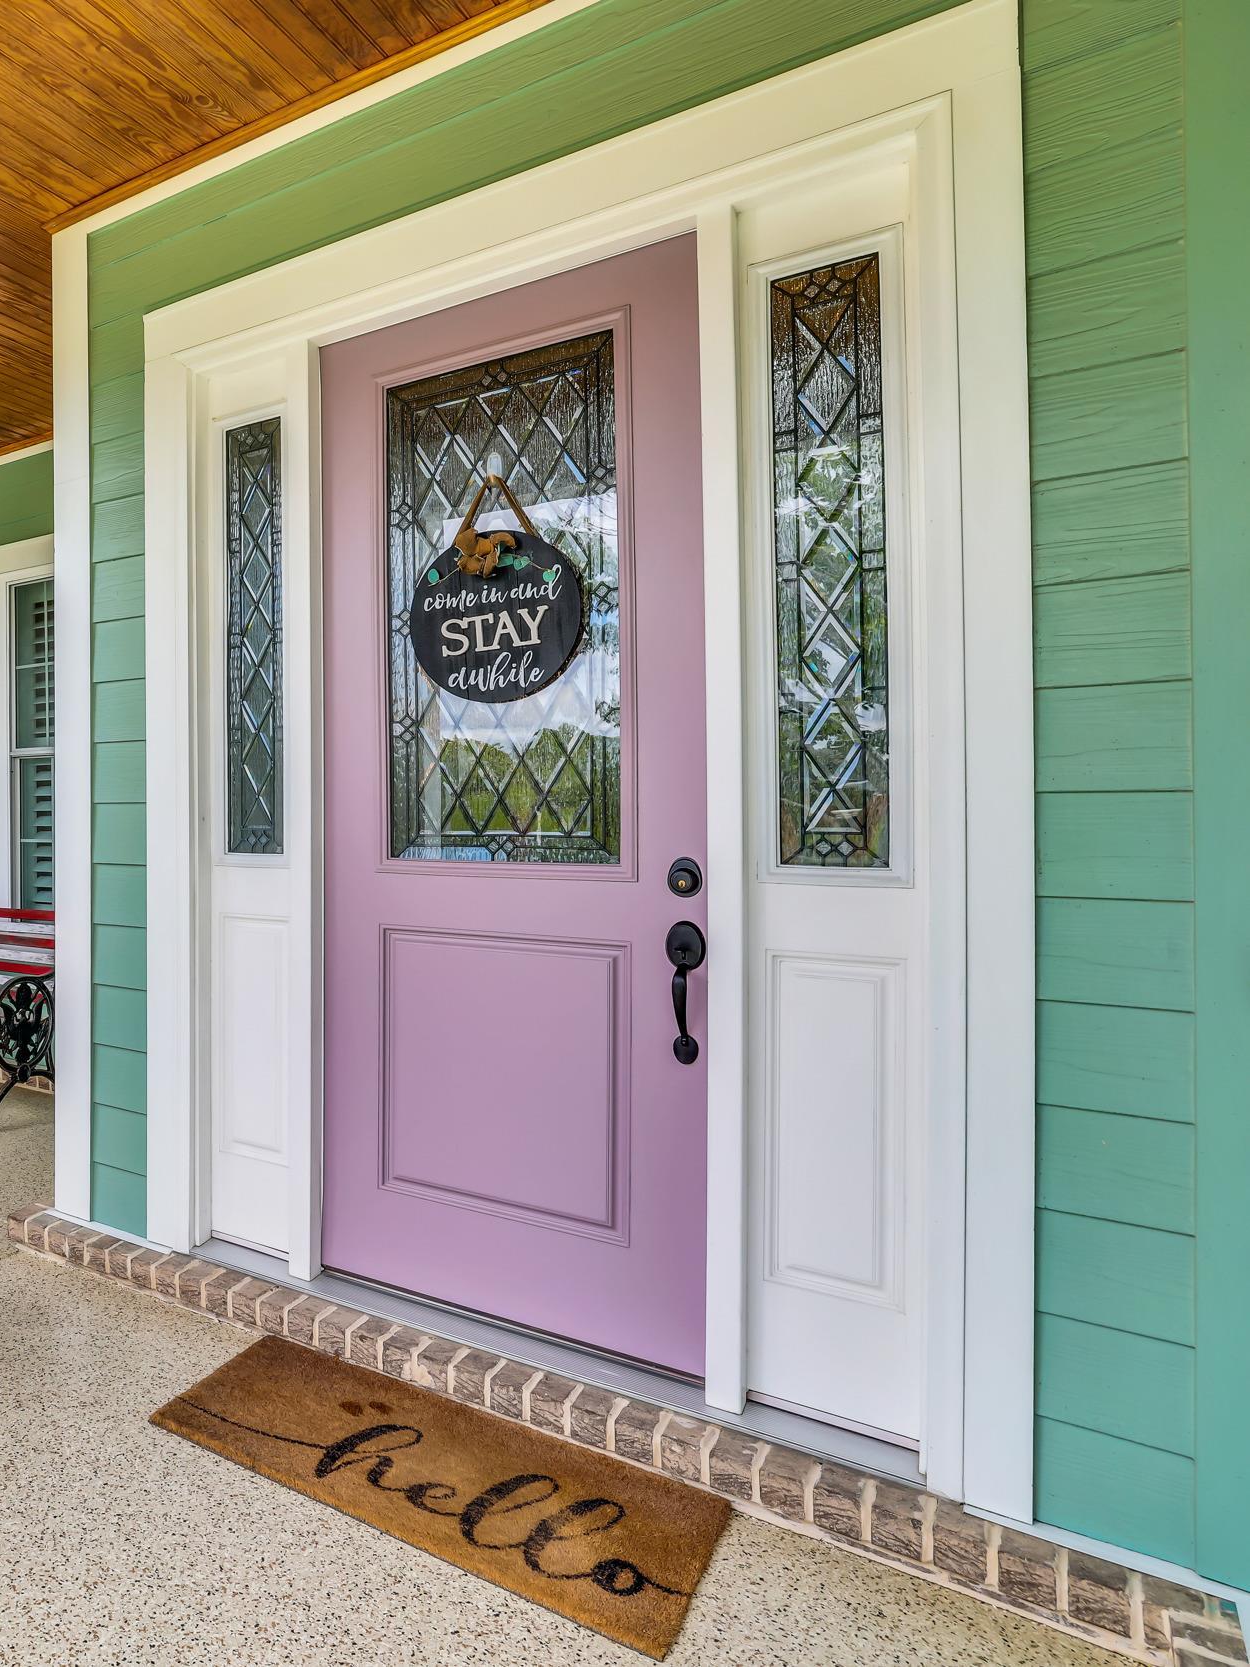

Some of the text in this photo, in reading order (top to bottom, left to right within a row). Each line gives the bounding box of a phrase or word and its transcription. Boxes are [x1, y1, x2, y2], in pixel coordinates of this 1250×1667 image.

[424, 564, 562, 612] come in and
[440, 605, 549, 657] STAY
[448, 651, 545, 692] awhile
[176, 1398, 692, 1598] hello
